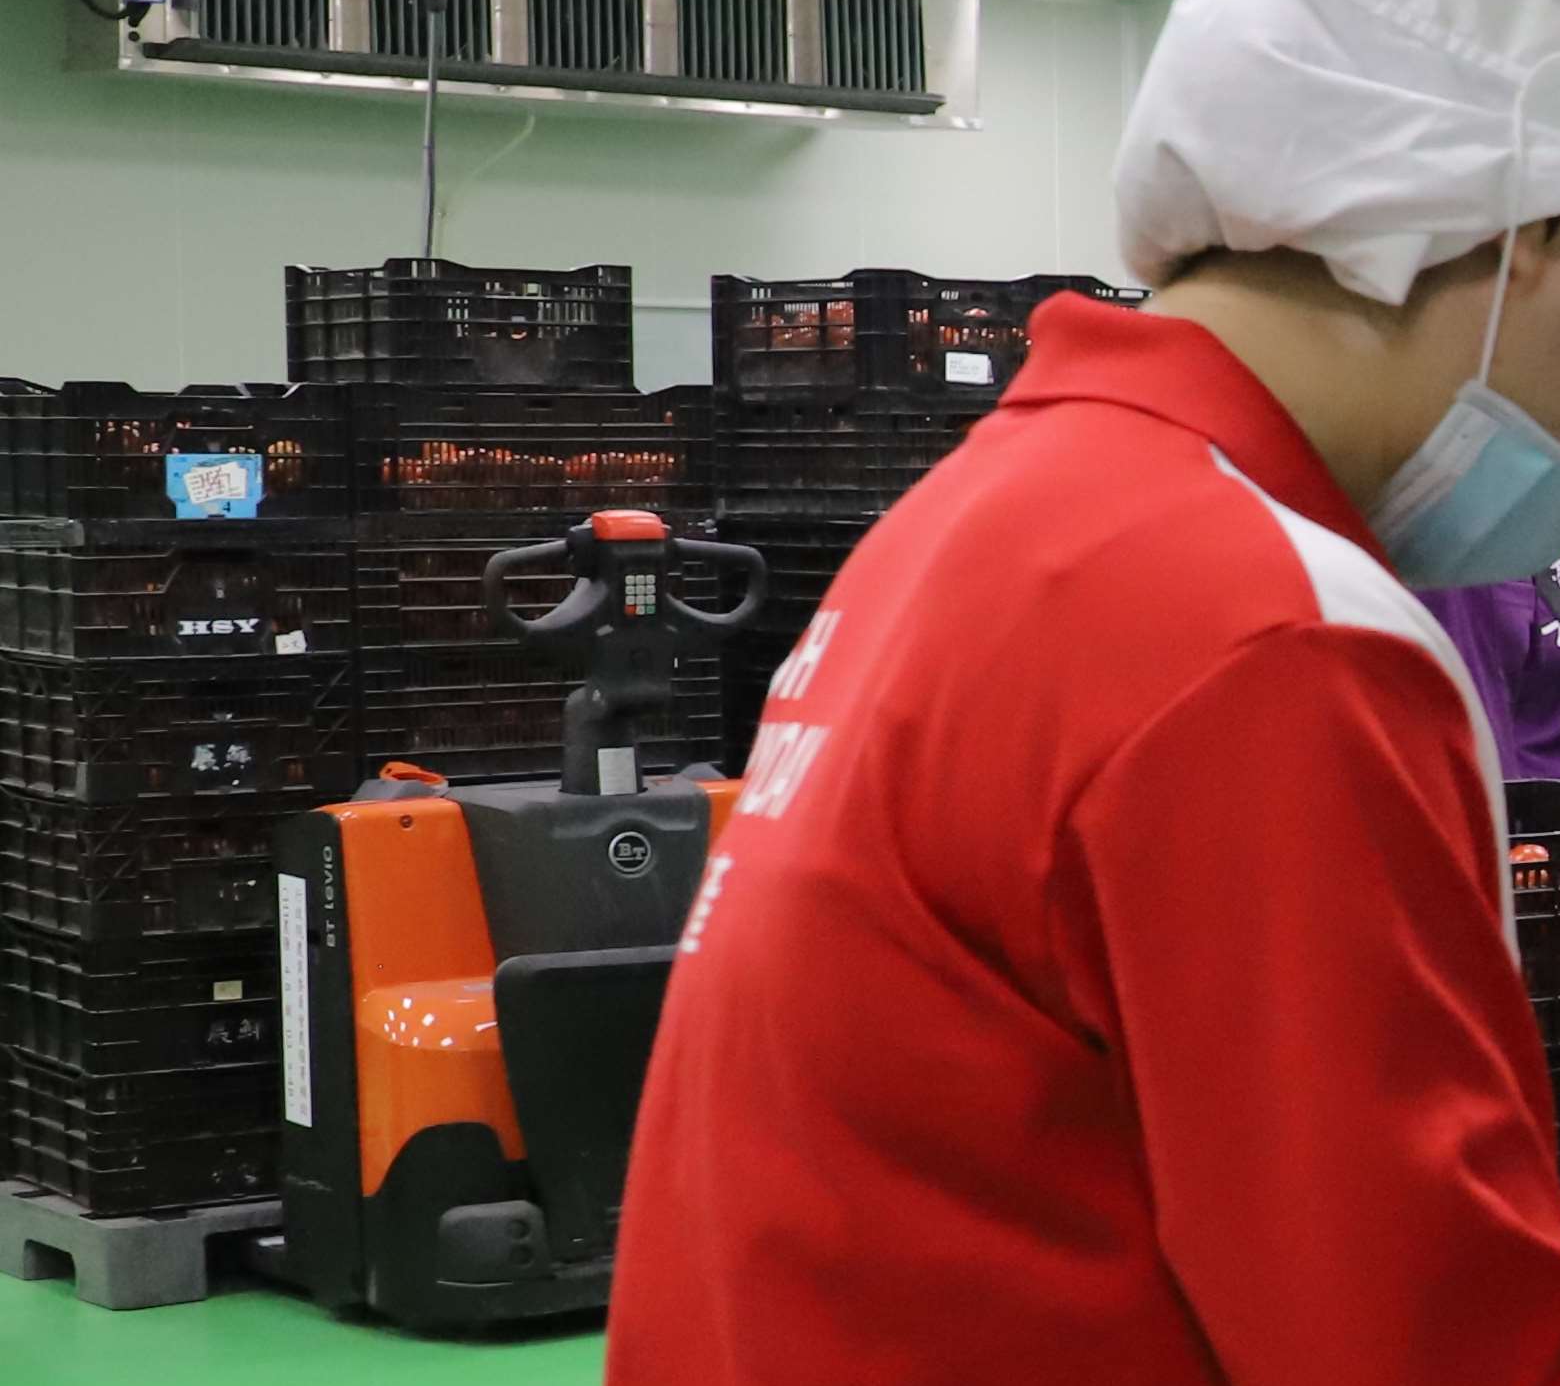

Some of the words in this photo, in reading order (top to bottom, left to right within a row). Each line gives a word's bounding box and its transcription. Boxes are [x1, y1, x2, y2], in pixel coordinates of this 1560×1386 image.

[178, 618, 260, 635] HSY
[618, 842, 645, 860] BT
[324, 919, 337, 948] BT
